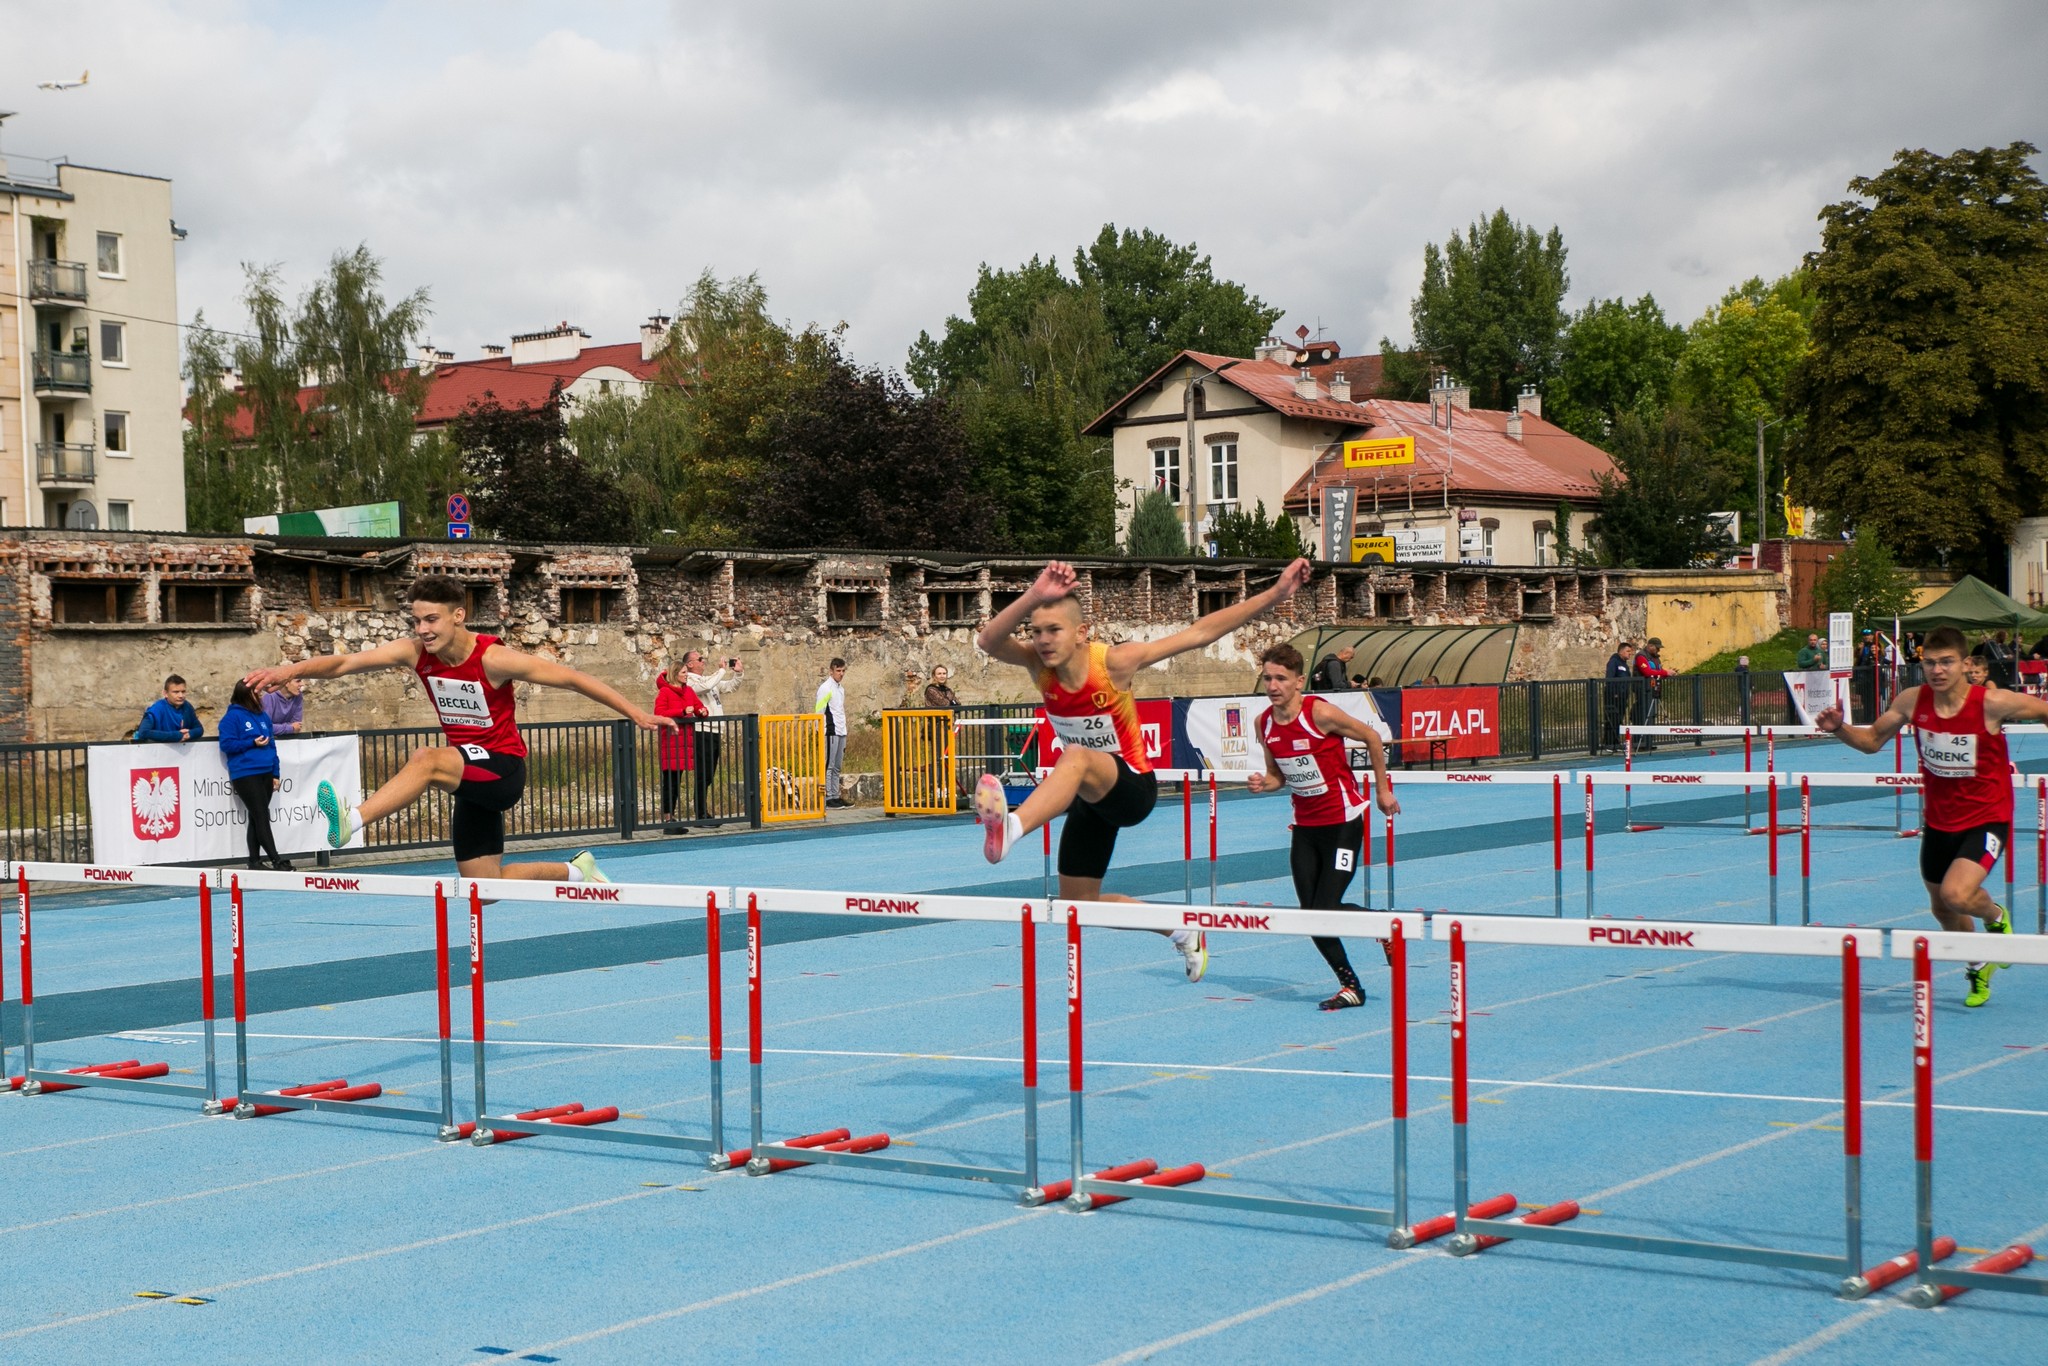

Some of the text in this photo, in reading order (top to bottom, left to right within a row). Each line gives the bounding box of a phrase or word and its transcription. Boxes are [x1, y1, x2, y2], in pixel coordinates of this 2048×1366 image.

[1351, 444, 1406, 461] PIRELLI
[1332, 489, 1348, 562] Firesto
[461, 683, 476, 694] 43
[438, 697, 481, 711] BECELA
[443, 716, 471, 724] KRAKÓW
[1083, 718, 1103, 730] 26
[1411, 708, 1491, 737] PZLA.PL
[1223, 740, 1247, 754] MZLA
[1951, 736, 1967, 746] 45
[1924, 746, 1970, 762] LORENC
[1295, 756, 1309, 767] 30
[1447, 774, 1492, 782] POLANIK
[1652, 774, 1702, 783] POLANIK
[1875, 776, 1922, 785] POLANI
[194, 803, 327, 831] Sportu urystyk
[1341, 853, 1349, 867] 5
[84, 868, 134, 881] POLANIK
[305, 877, 360, 891] POLANIK
[555, 886, 619, 901] POLANIK
[846, 898, 920, 914] POLANIK
[1183, 911, 1270, 931] POLANIK
[1589, 926, 1694, 947] POLANIK
[1067, 945, 1075, 994] POLANIK
[1450, 964, 1459, 1017] POLANIK
[1914, 982, 1926, 1042] POLANIK
